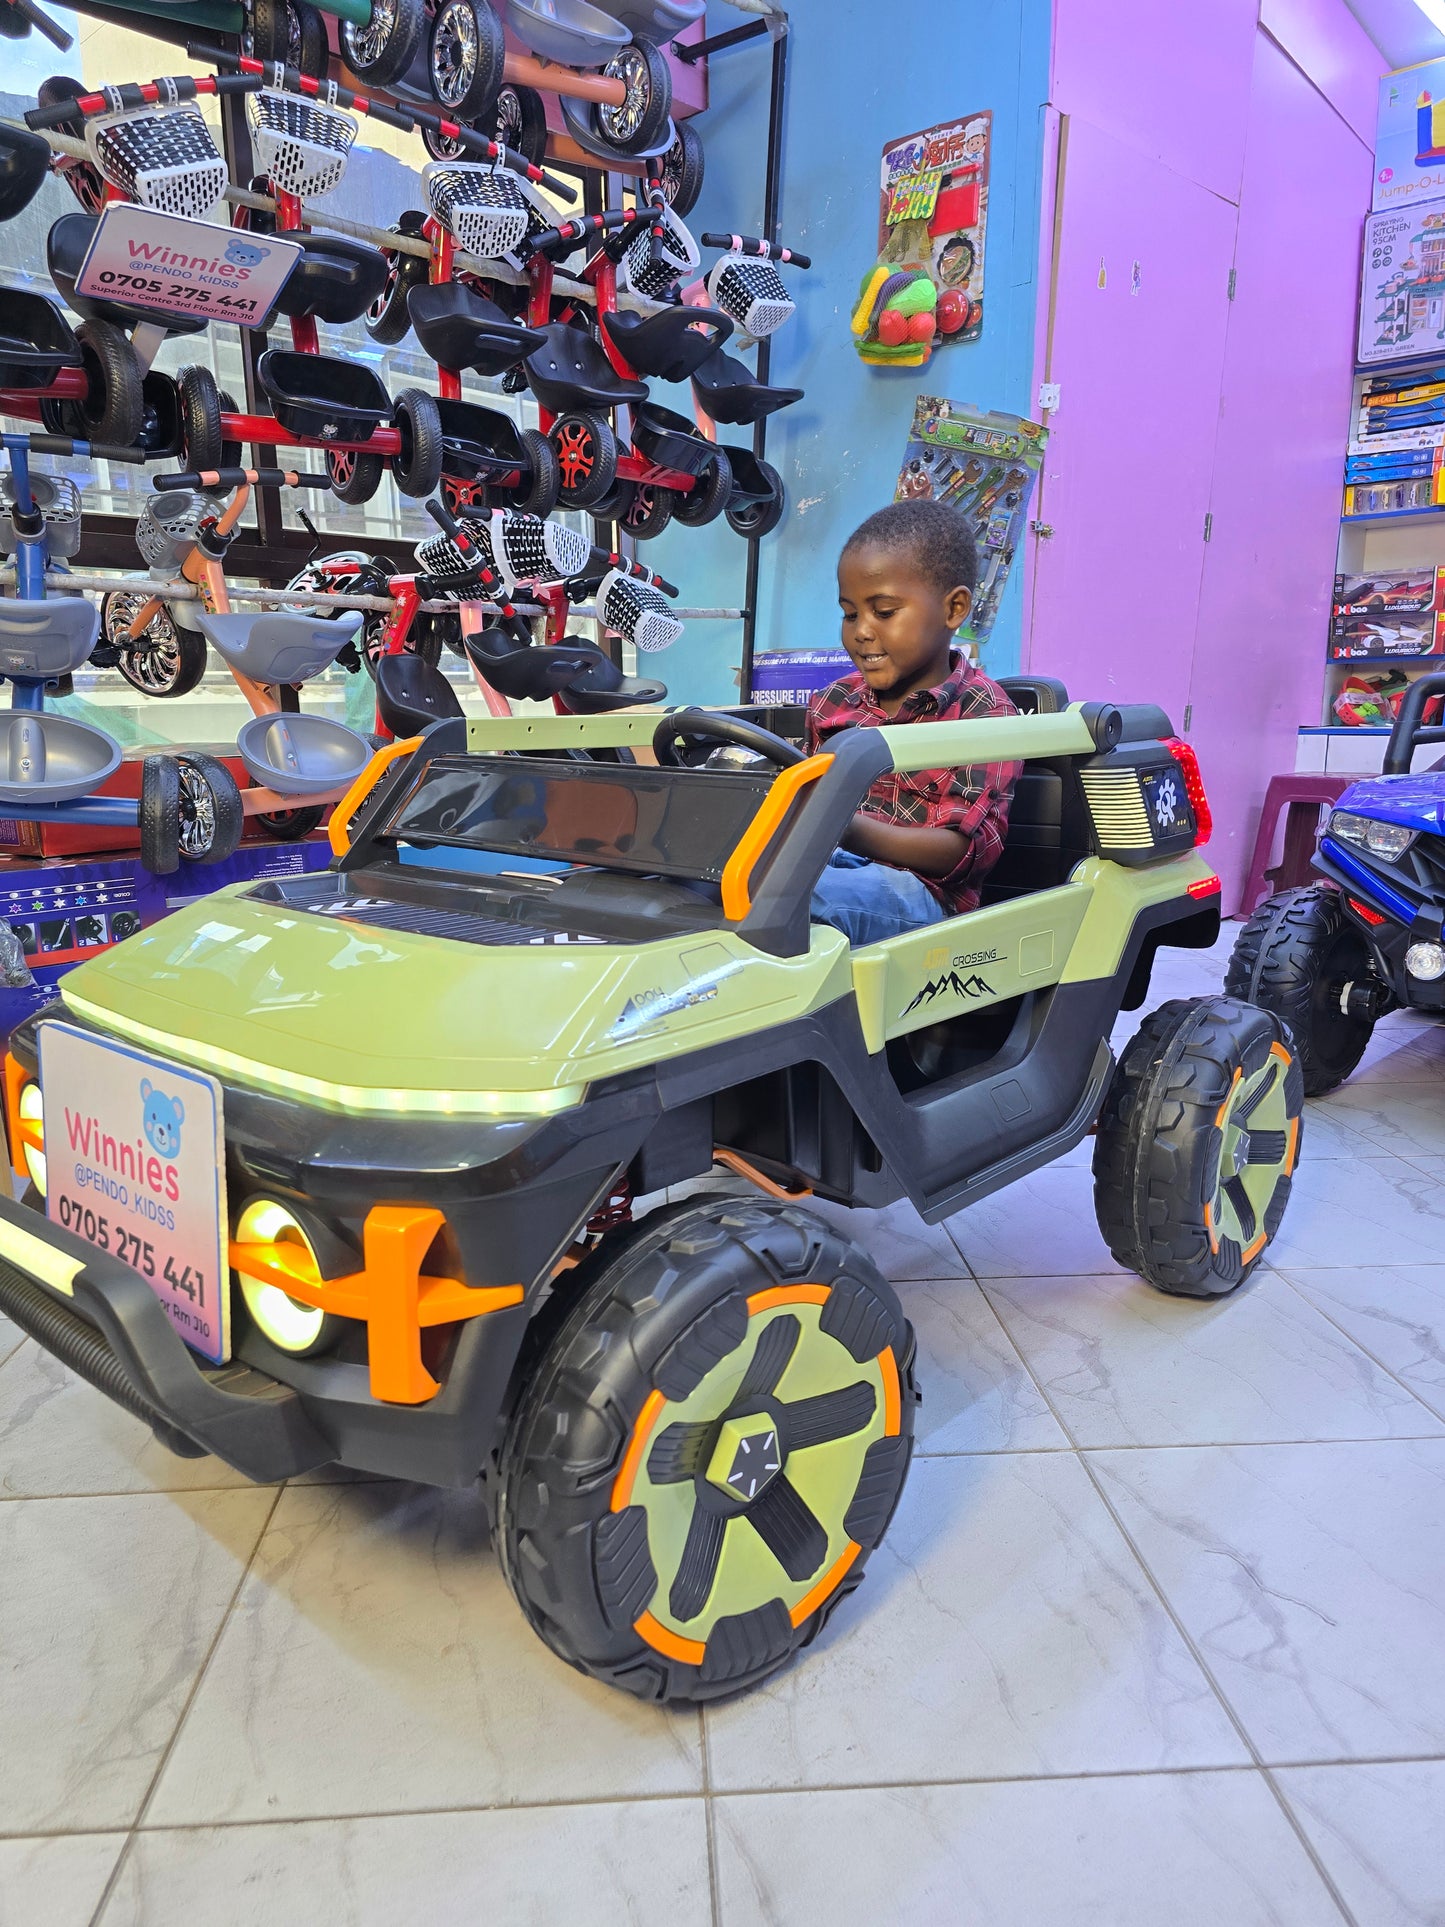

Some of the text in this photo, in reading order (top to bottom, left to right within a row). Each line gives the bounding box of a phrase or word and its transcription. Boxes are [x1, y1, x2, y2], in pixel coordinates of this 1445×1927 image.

[1372, 234, 1397, 245] 95CM
[1373, 222, 1411, 237] KITCHEN
[128, 239, 252, 281] Winnies
[90, 283, 254, 321] Superior Centre 3rd Floor Rm J10
[99, 270, 258, 312] 0705 275 441
[789, 656, 812, 664] SAFETY
[812, 656, 828, 664] GATE
[751, 689, 811, 705] RESSURE FIT
[952, 948, 997, 967] CROSSING
[64, 1106, 180, 1202] Winnies
[75, 1162, 175, 1231] @PENDO_KIDSS
[59, 1194, 206, 1308] 0705 275 441
[173, 1303, 191, 1324] Rm
[193, 1314, 210, 1339] J10
